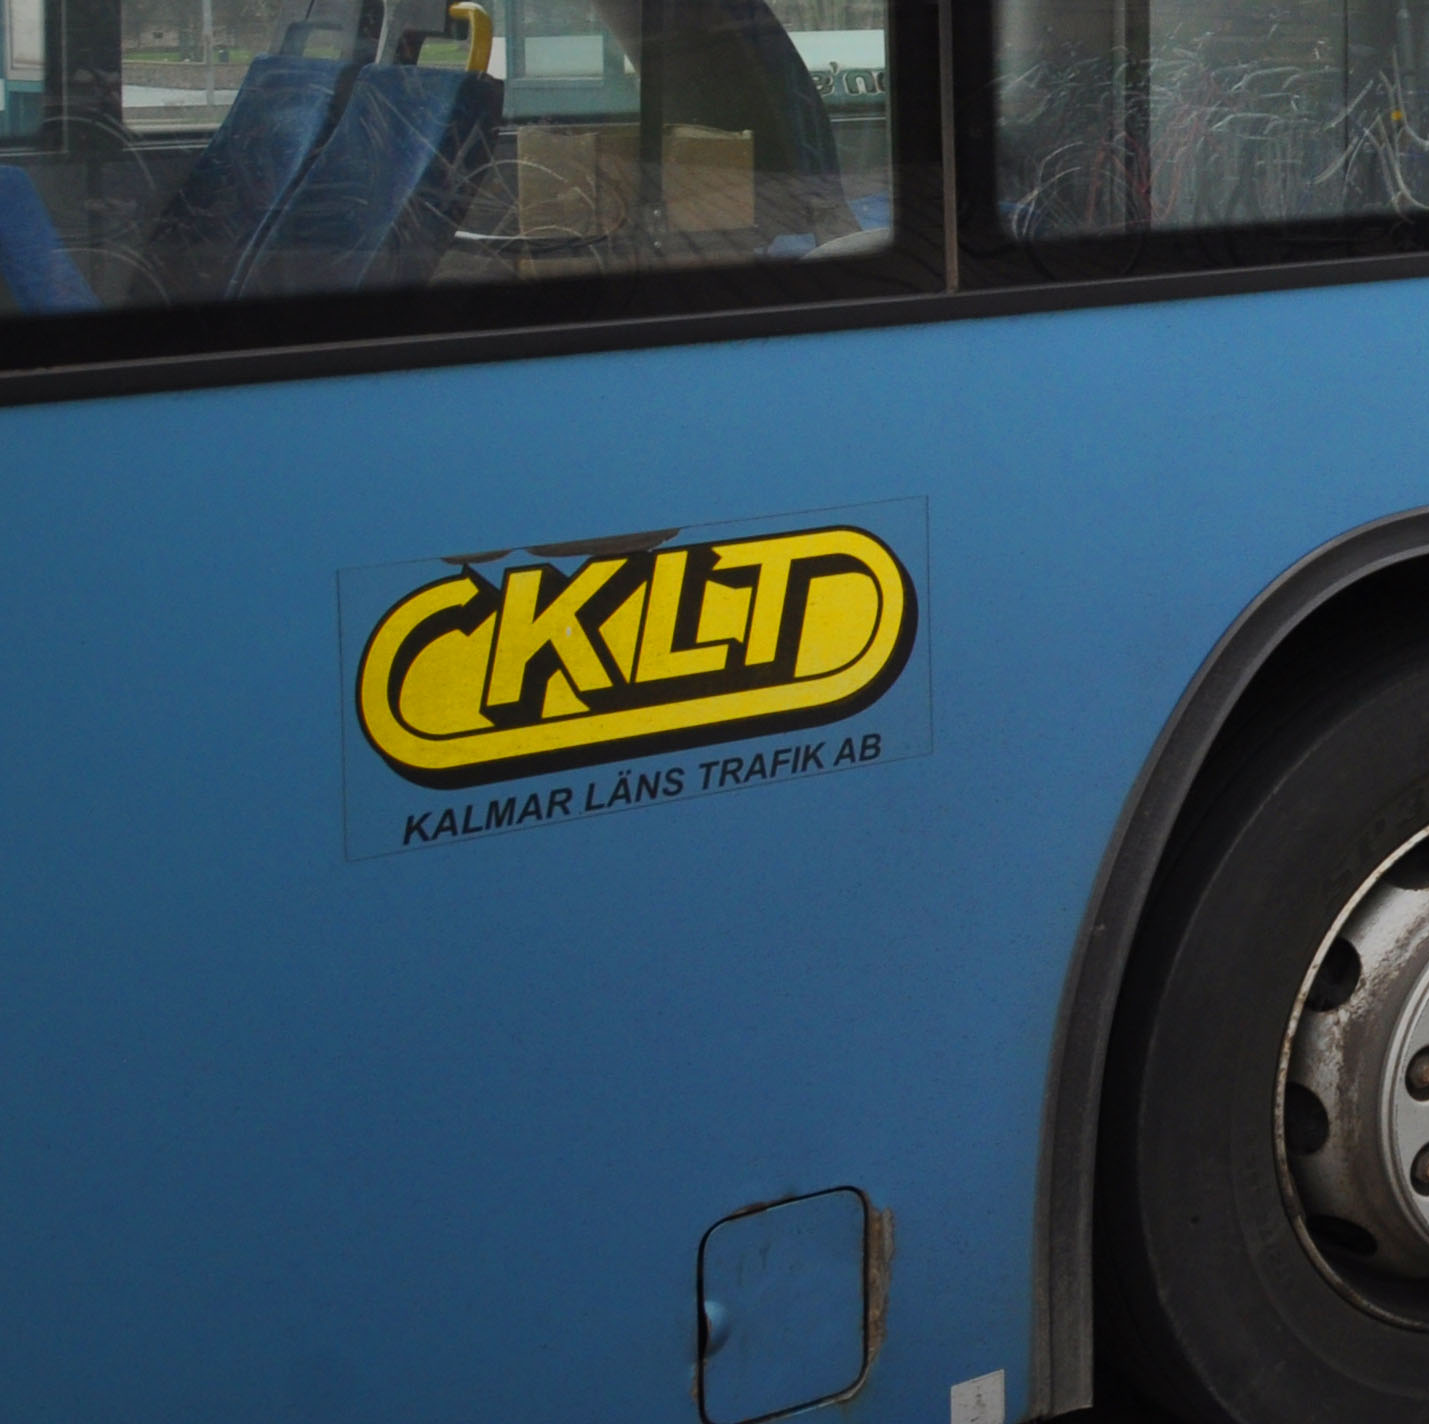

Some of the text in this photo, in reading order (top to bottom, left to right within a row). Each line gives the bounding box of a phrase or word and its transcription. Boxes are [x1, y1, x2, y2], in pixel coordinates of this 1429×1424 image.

[402, 732, 883, 847] KALMAR LÄNS TRAFIK AB
